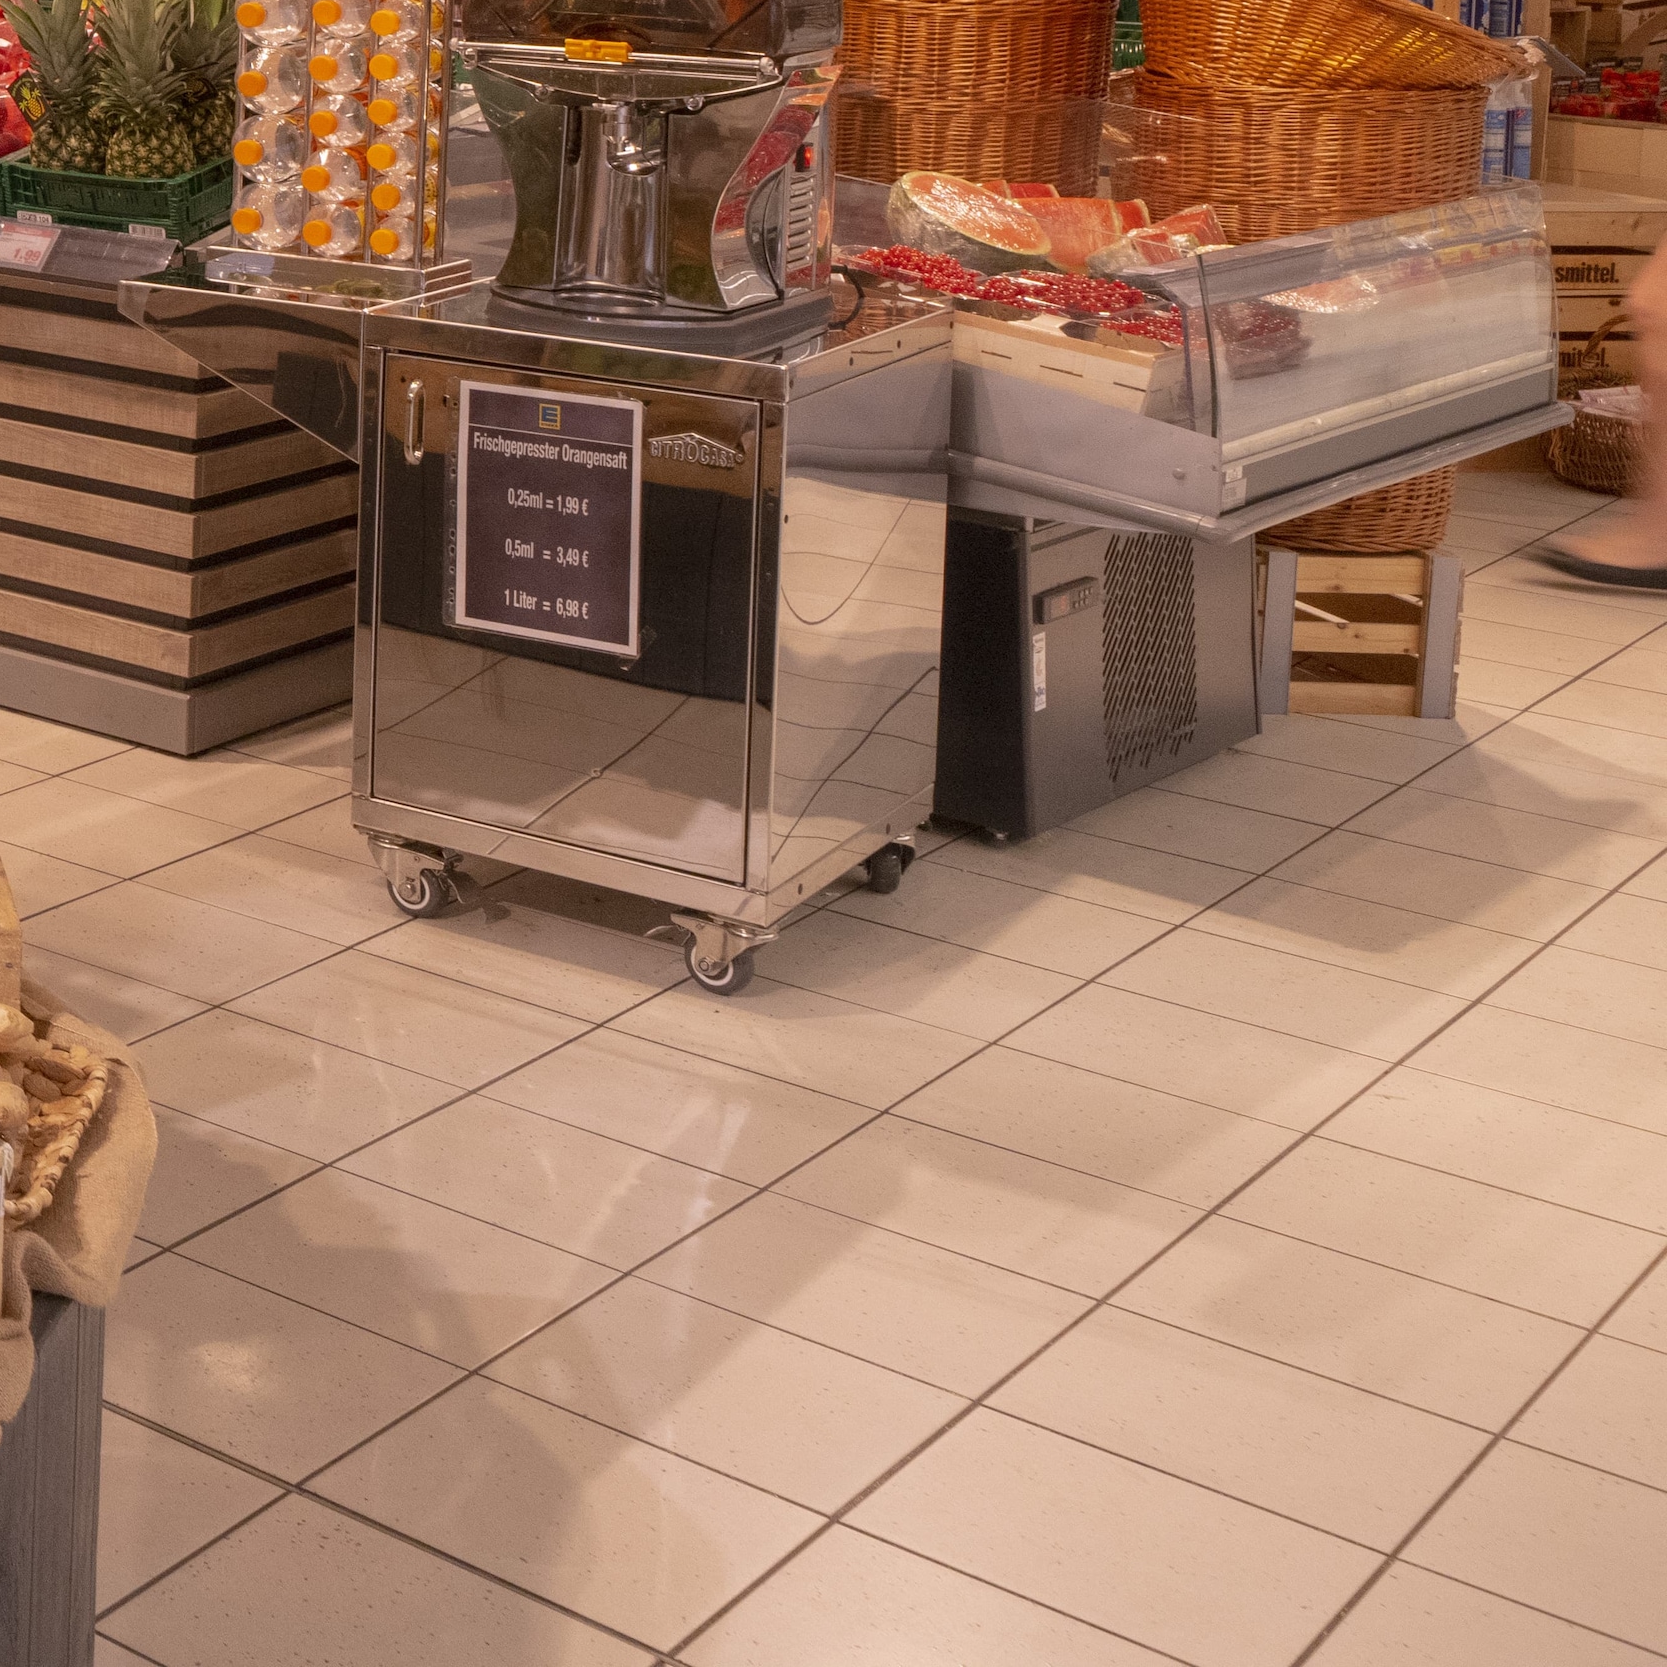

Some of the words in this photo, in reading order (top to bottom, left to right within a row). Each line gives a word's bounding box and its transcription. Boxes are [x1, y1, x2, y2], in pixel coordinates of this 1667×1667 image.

[13, 247, 40, 262] 1.99
[473, 431, 559, 460] Frischgepresster
[561, 444, 628, 470] Orangensaft
[650, 438, 735, 468] CITROCASA
[507, 488, 543, 510] 0,25ml
[556, 495, 579, 516] 1,99
[581, 499, 589, 516] €
[505, 538, 534, 559] 0,5ml
[556, 547, 579, 567] 3,49
[581, 550, 589, 568] €
[504, 589, 510, 606] 1
[513, 590, 538, 610] Liter
[556, 599, 579, 618] 6,98
[581, 602, 589, 619] €
